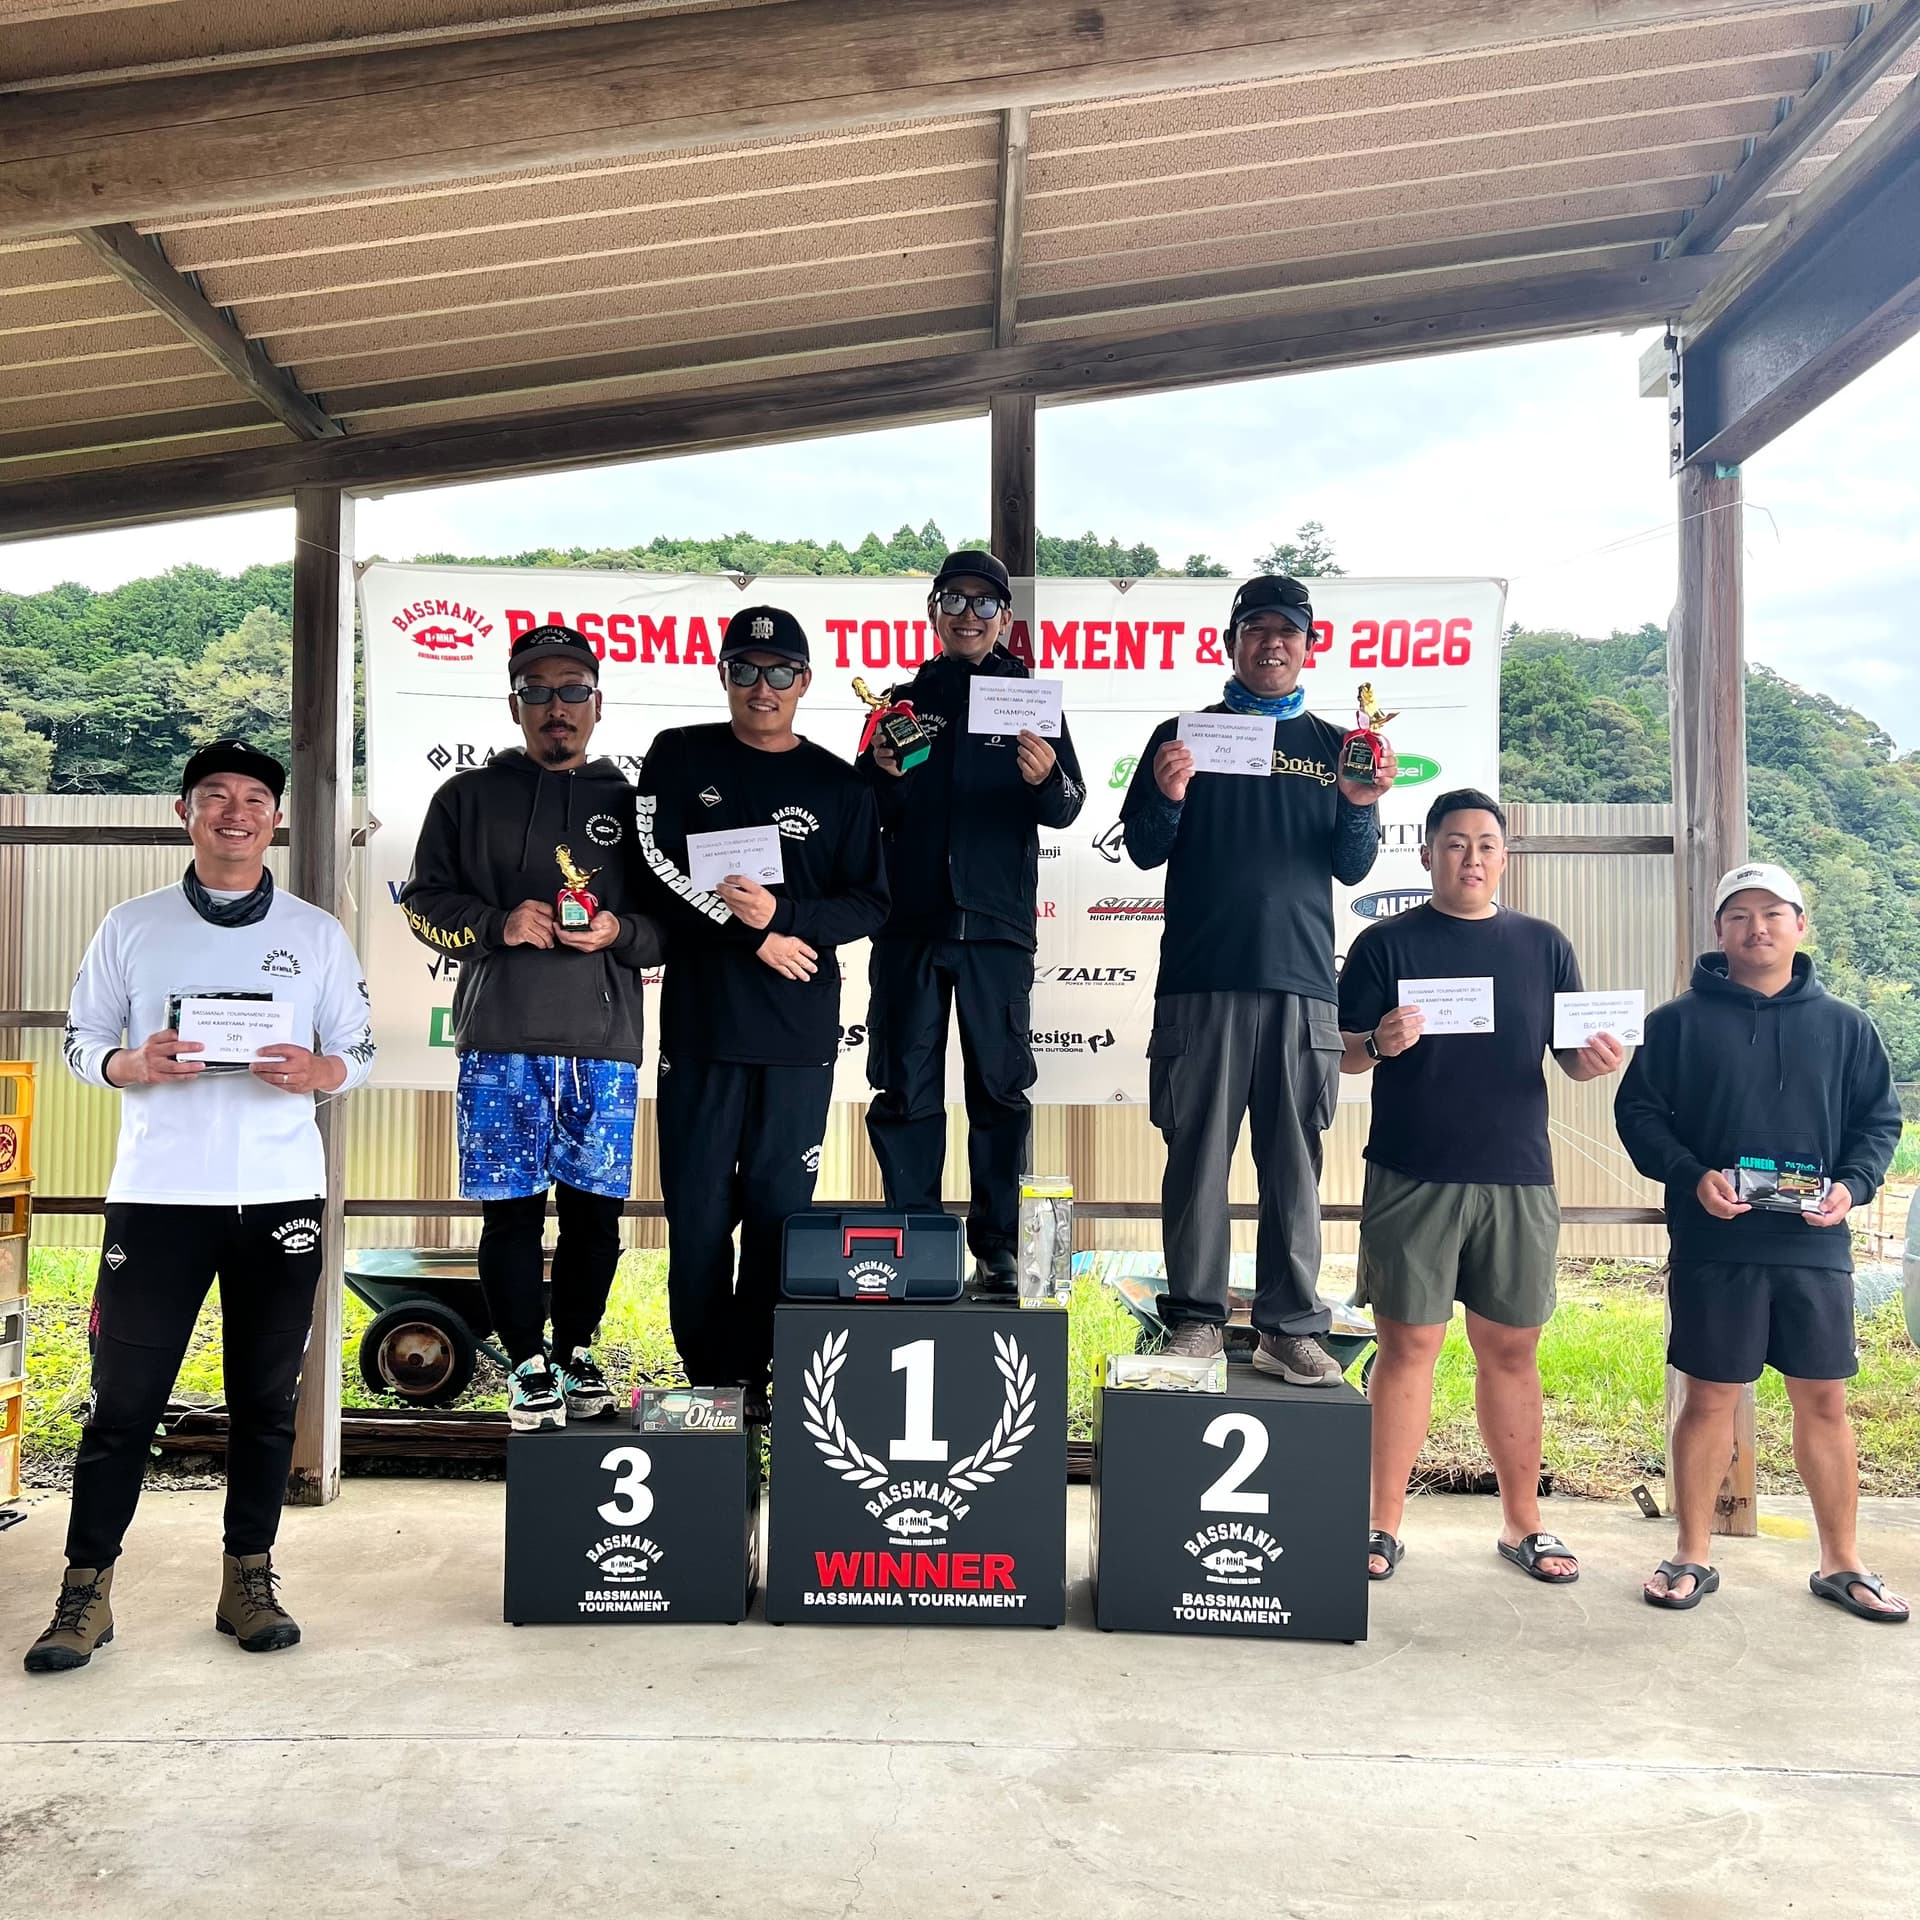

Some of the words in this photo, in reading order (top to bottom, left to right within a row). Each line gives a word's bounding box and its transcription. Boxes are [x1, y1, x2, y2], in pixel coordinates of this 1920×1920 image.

[391, 599, 494, 638] BASSMANIA
[1196, 627, 1225, 666] &
[1350, 617, 1473, 669] 2026
[993, 708, 1036, 717] CHAMPION
[1214, 745, 1232, 754] 2nd
[771, 806, 820, 833] BASSMANIA
[635, 795, 734, 926] Bassmania
[1038, 846, 1061, 858] anji
[261, 949, 301, 976] BASSMANIA
[226, 1032, 242, 1041] 5th
[271, 1218, 321, 1241] BASSMANIA
[847, 1260, 898, 1281] BASSMANIA
[888, 1338, 949, 1462] 1
[684, 1404, 737, 1430] Ohira
[1199, 1412, 1270, 1514] 2
[596, 1446, 655, 1527] 3
[864, 1480, 971, 1521] BASSMANIA
[585, 1534, 664, 1563] BASSMANIA
[1183, 1522, 1284, 1562] BASSMANIA
[1536, 1534, 1558, 1545] NIKE
[814, 1551, 1017, 1590] WINNER
[578, 1600, 671, 1612] TOURNAMENT
[585, 1590, 663, 1601] BASSMANIA
[803, 1592, 904, 1606] BASSMANIA
[908, 1593, 1027, 1608] TOURNAMENT
[1182, 1592, 1283, 1610] BASSMANIA
[1172, 1606, 1292, 1625] TOURNAMENT
